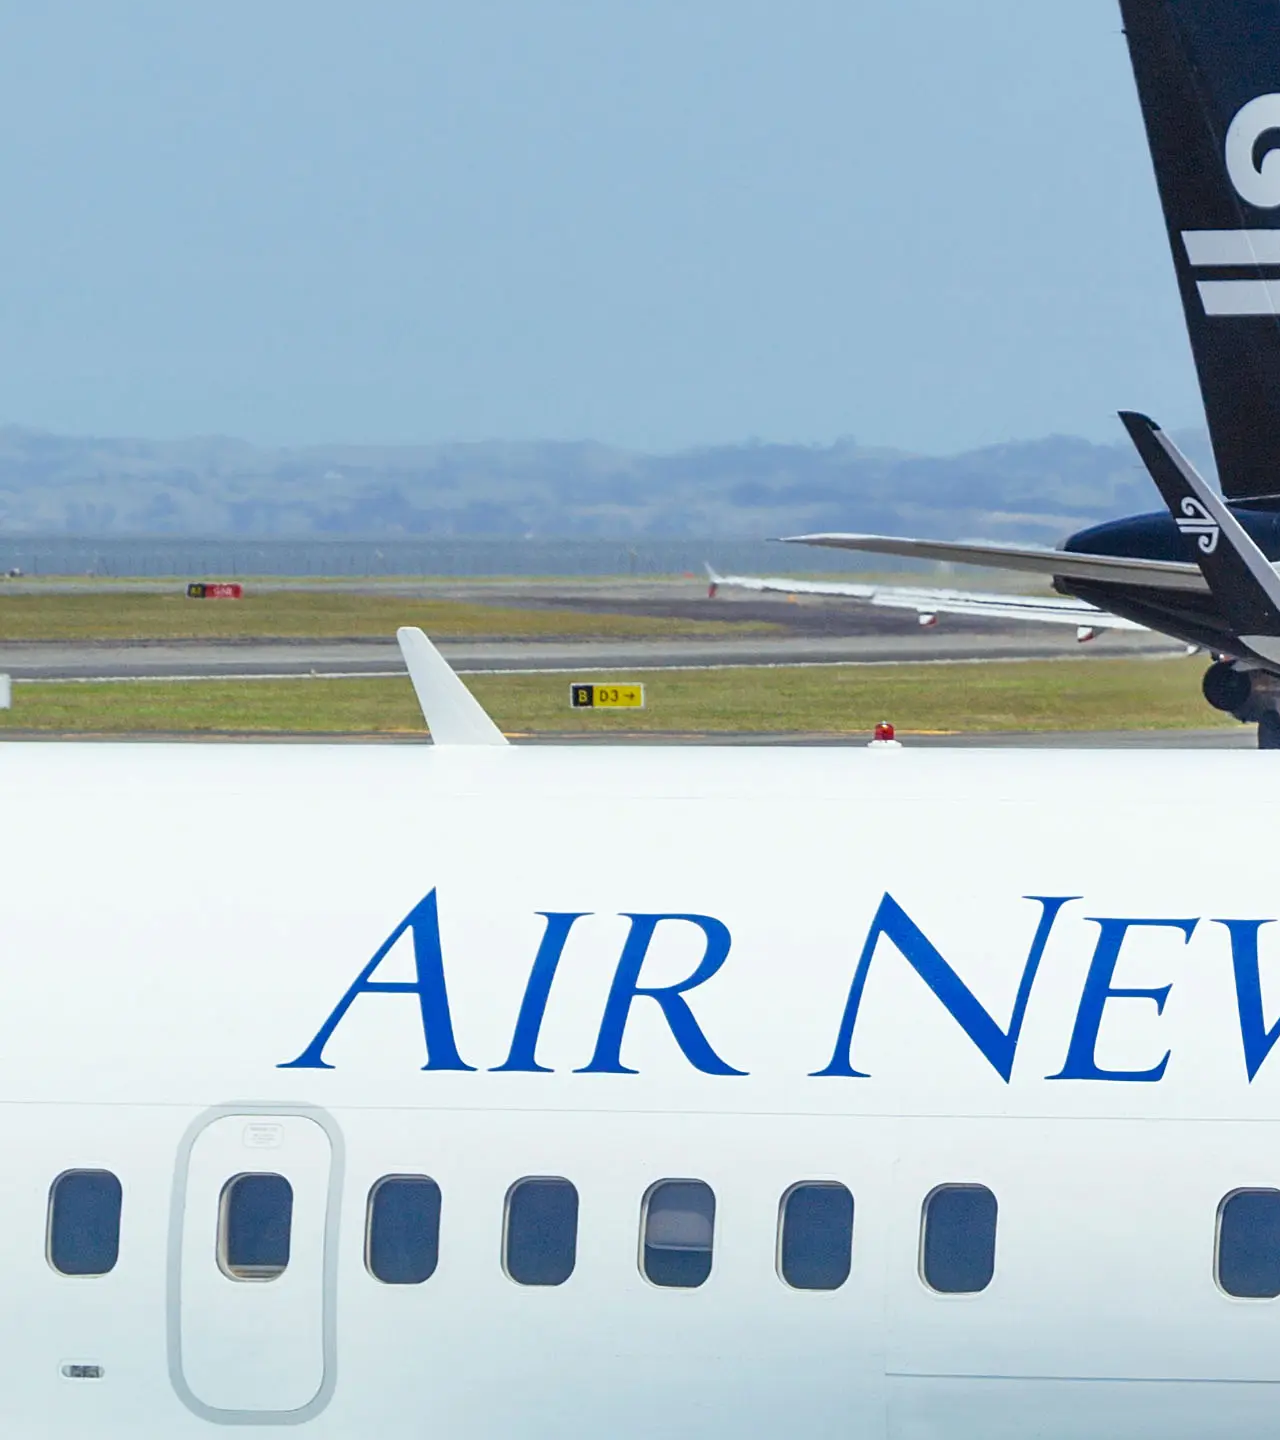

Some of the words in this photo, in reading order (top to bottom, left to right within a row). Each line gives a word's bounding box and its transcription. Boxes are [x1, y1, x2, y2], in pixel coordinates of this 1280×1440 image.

[578, 689, 589, 703] B
[599, 689, 619, 702] D3
[278, 887, 749, 1077] AIR
